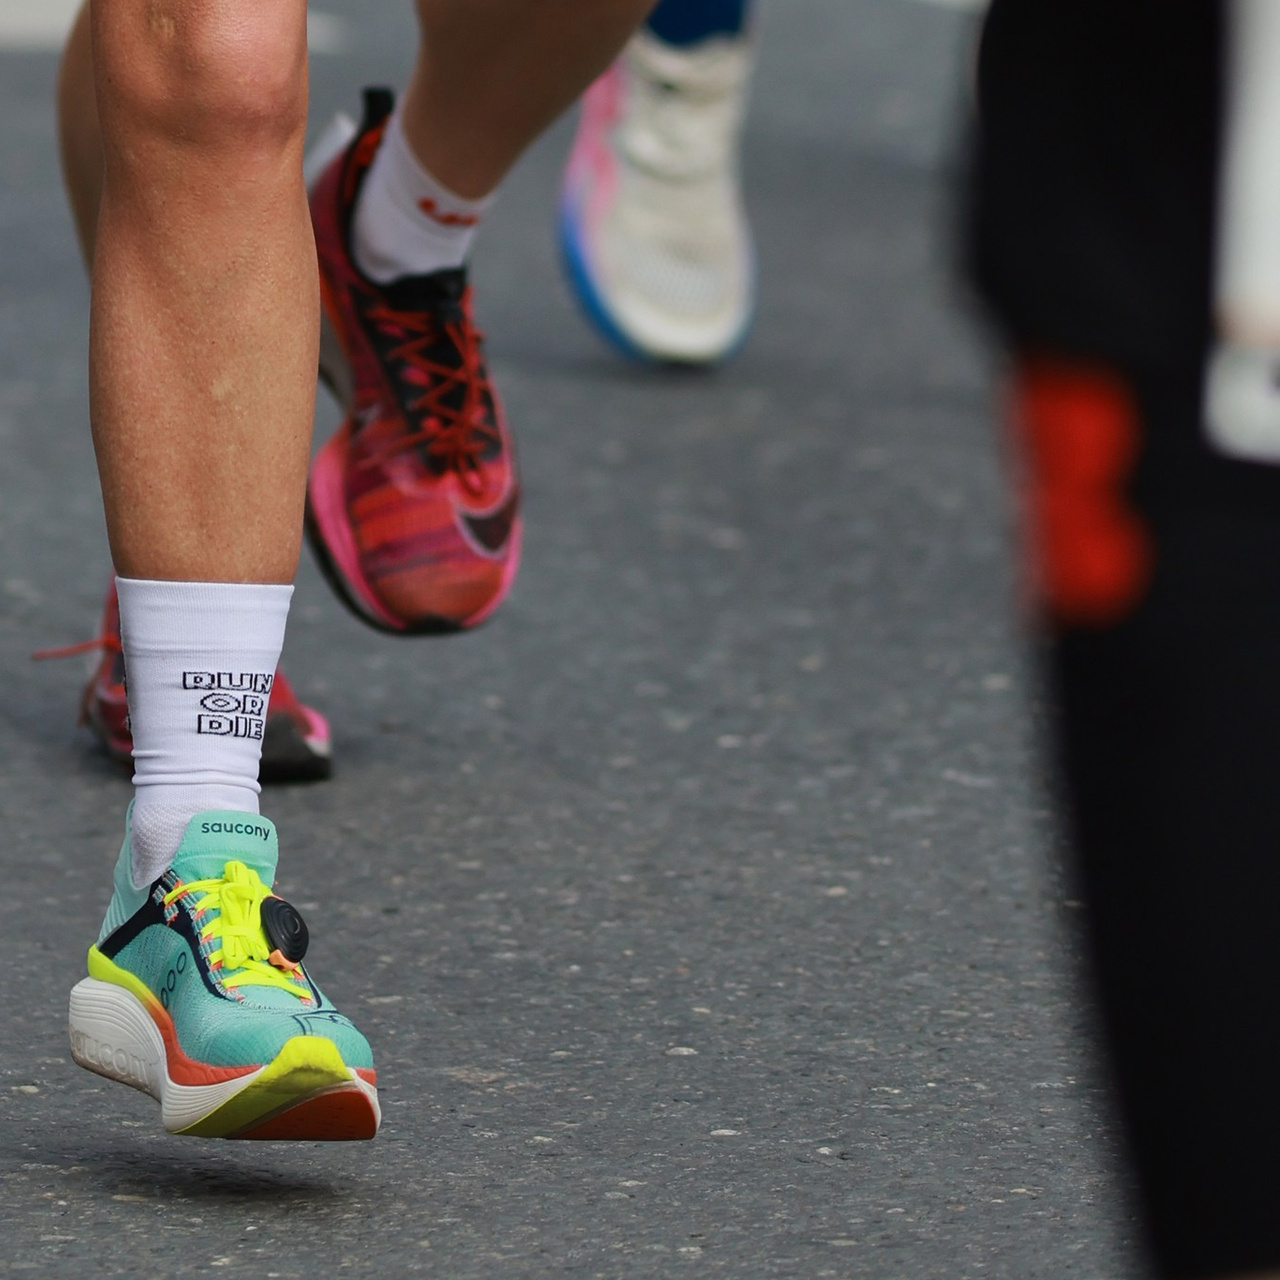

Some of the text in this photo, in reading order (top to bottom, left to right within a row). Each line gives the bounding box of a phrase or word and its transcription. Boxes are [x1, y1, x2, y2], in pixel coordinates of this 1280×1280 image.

[183, 671, 273, 694] RUN
[200, 692, 264, 716] OR
[197, 714, 264, 740] DIE
[201, 822, 270, 841] saucony
